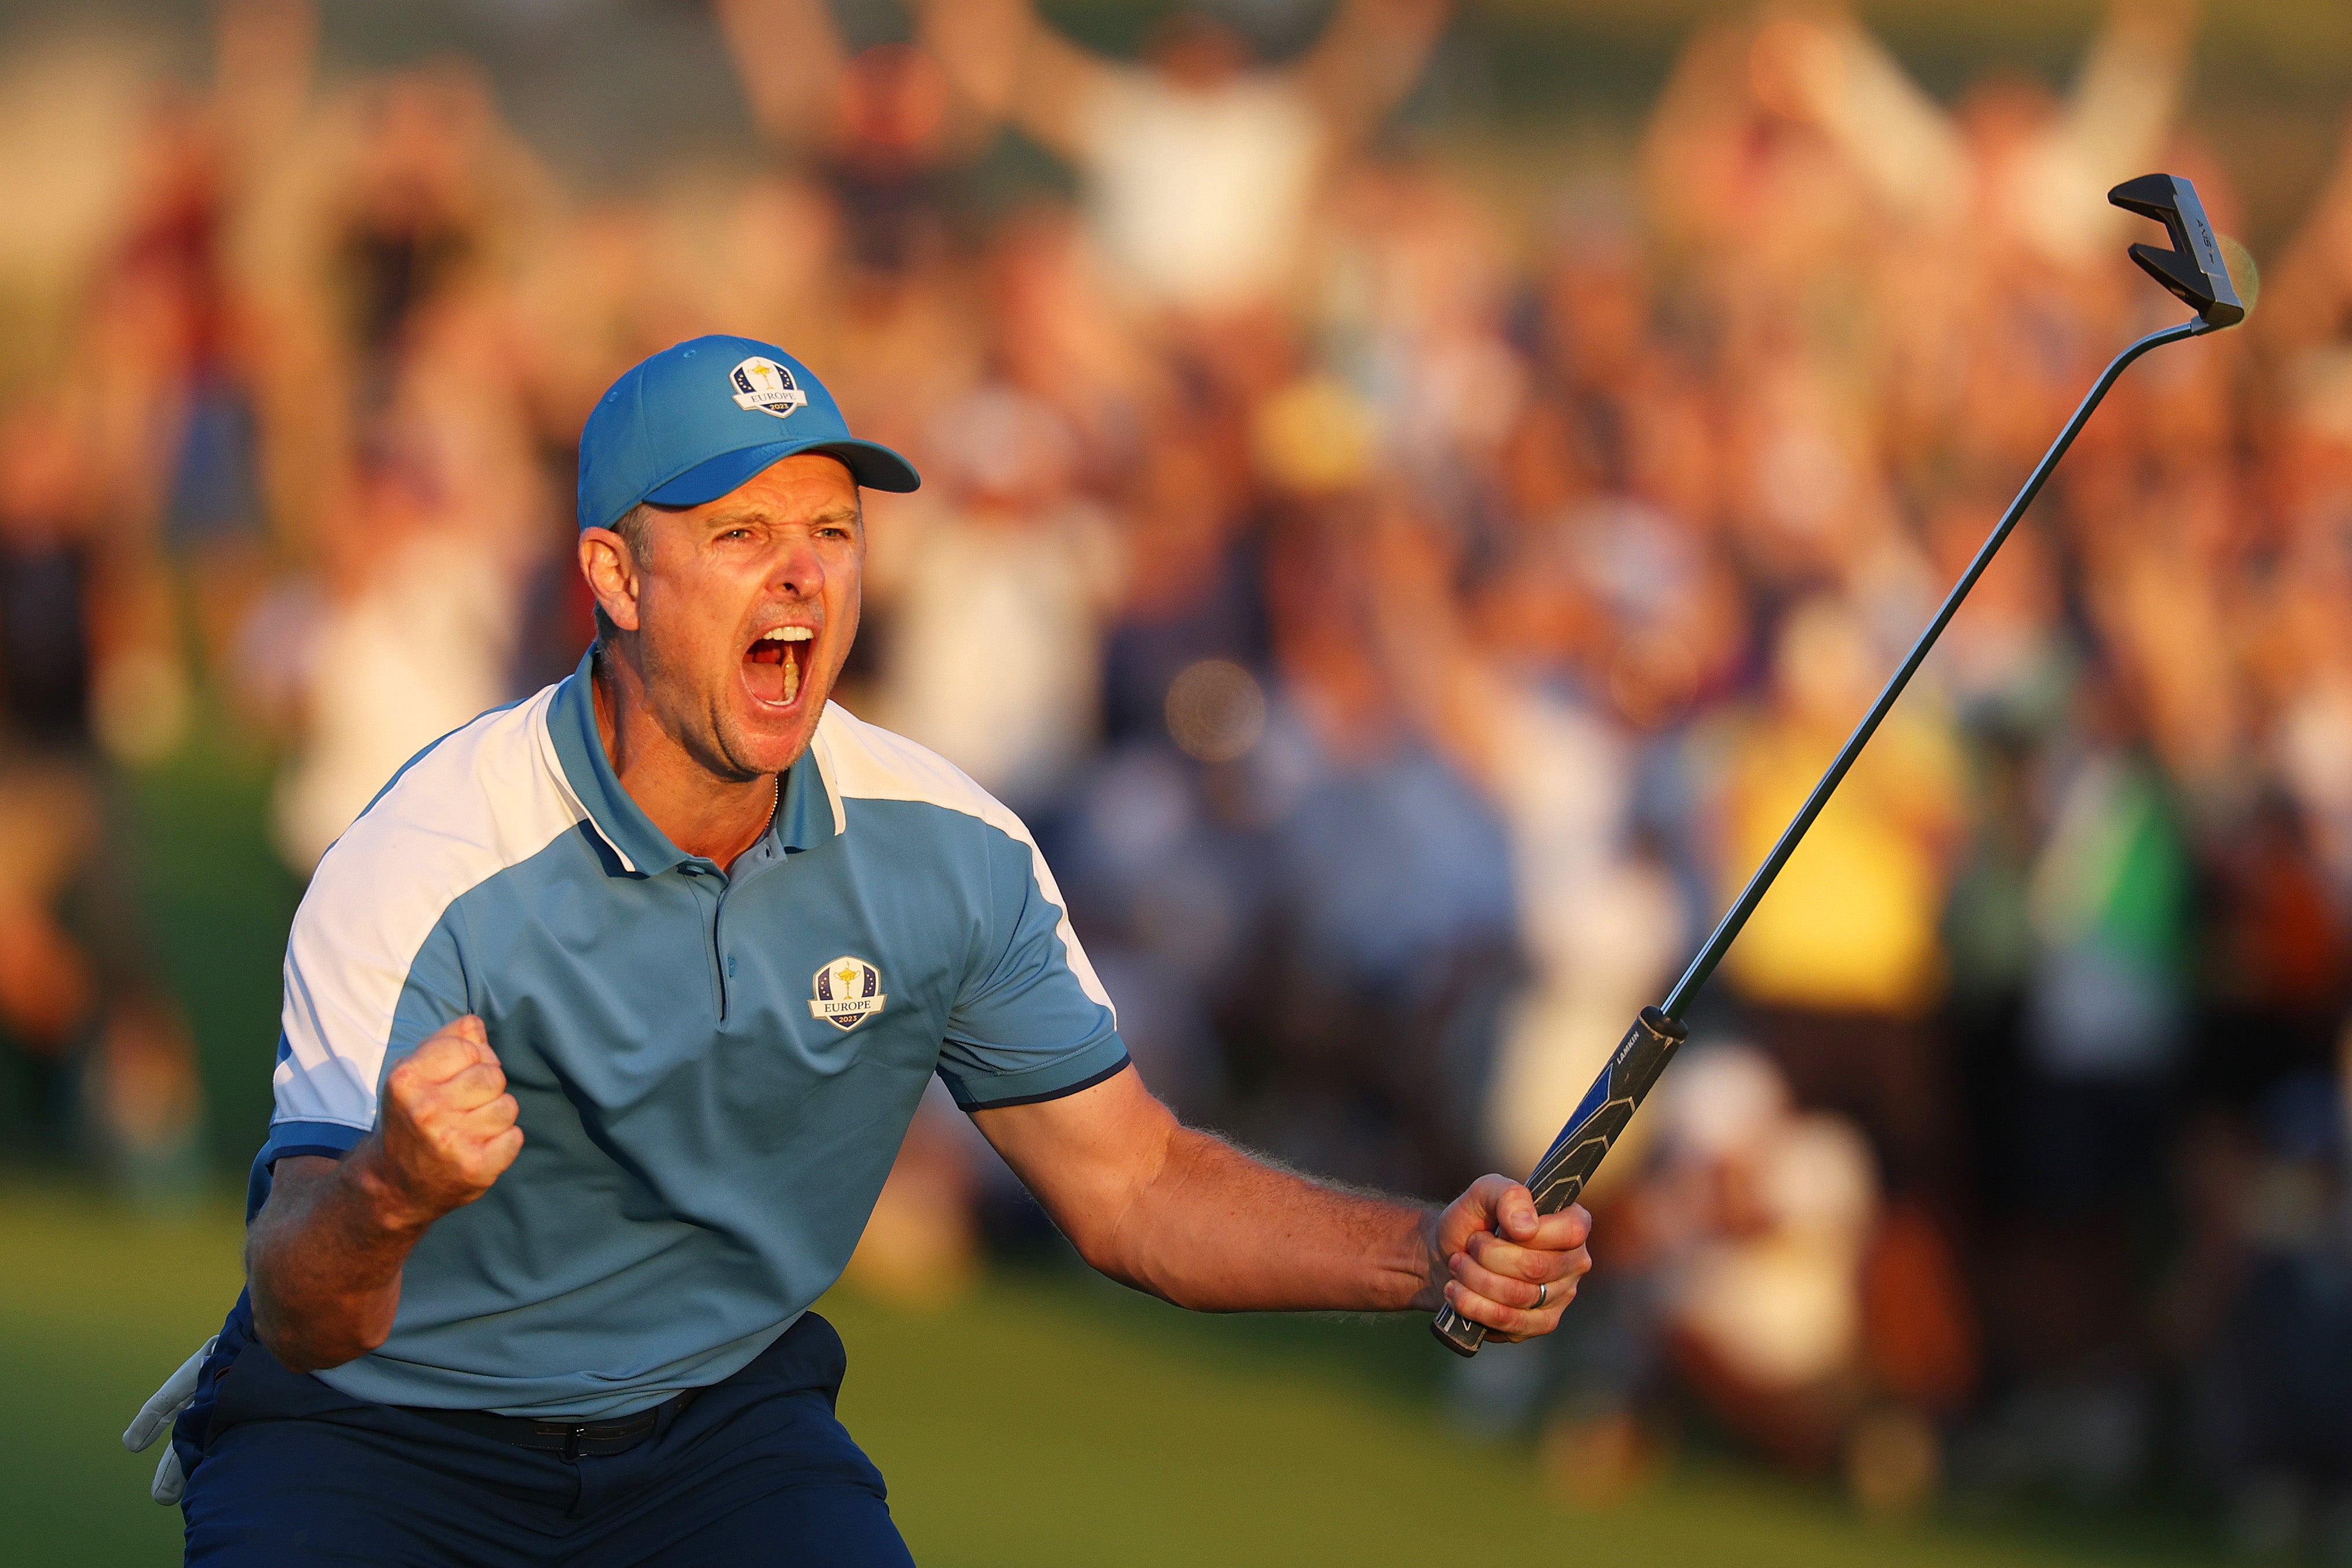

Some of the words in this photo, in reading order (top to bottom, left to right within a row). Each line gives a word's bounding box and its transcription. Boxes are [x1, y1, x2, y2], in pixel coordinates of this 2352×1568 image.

[751, 392, 796, 403] EUROPE
[824, 1000, 871, 1012] EUROPE
[1616, 1031, 1640, 1065] LAMKIN
